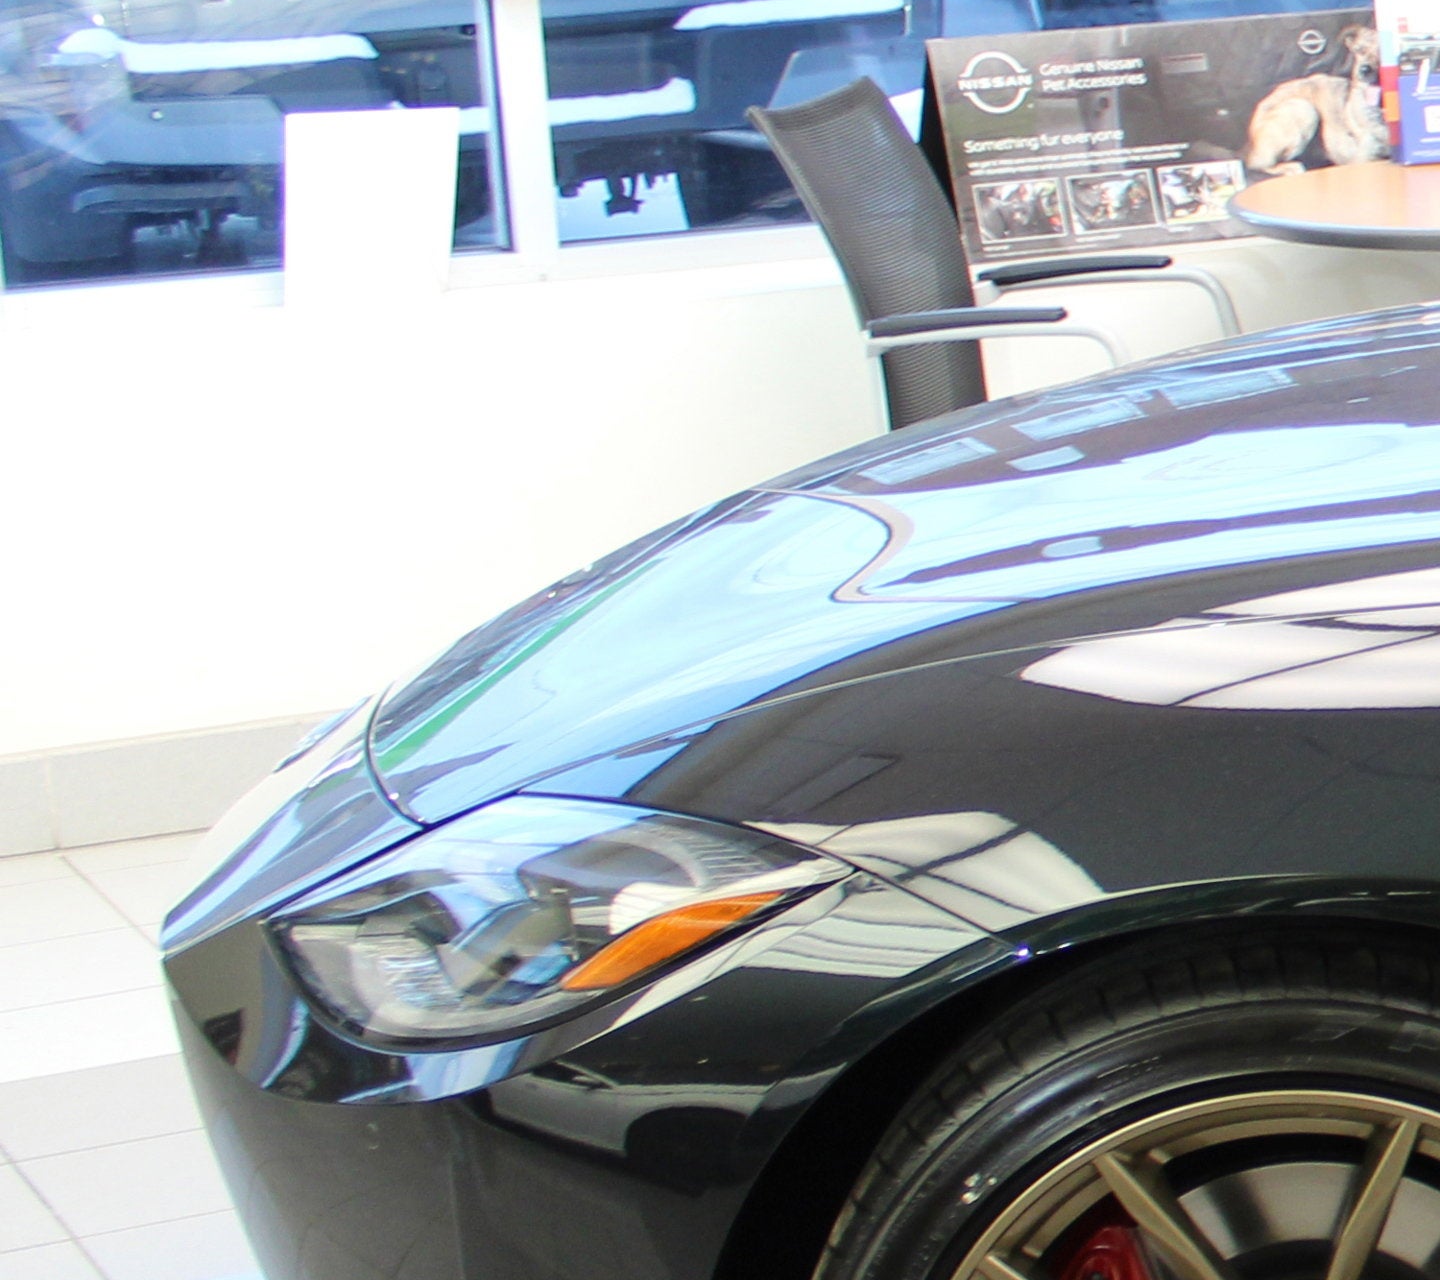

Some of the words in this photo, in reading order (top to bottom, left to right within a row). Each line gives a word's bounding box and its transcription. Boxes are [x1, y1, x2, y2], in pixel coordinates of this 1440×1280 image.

[1039, 60, 1095, 76] Genuine
[1096, 57, 1144, 72] Nissan
[958, 75, 1033, 91] NISSAN
[1042, 77, 1068, 91] Pet
[1069, 74, 1148, 90] Accessories
[963, 135, 1040, 154] Something
[1060, 129, 1125, 148] everyone
